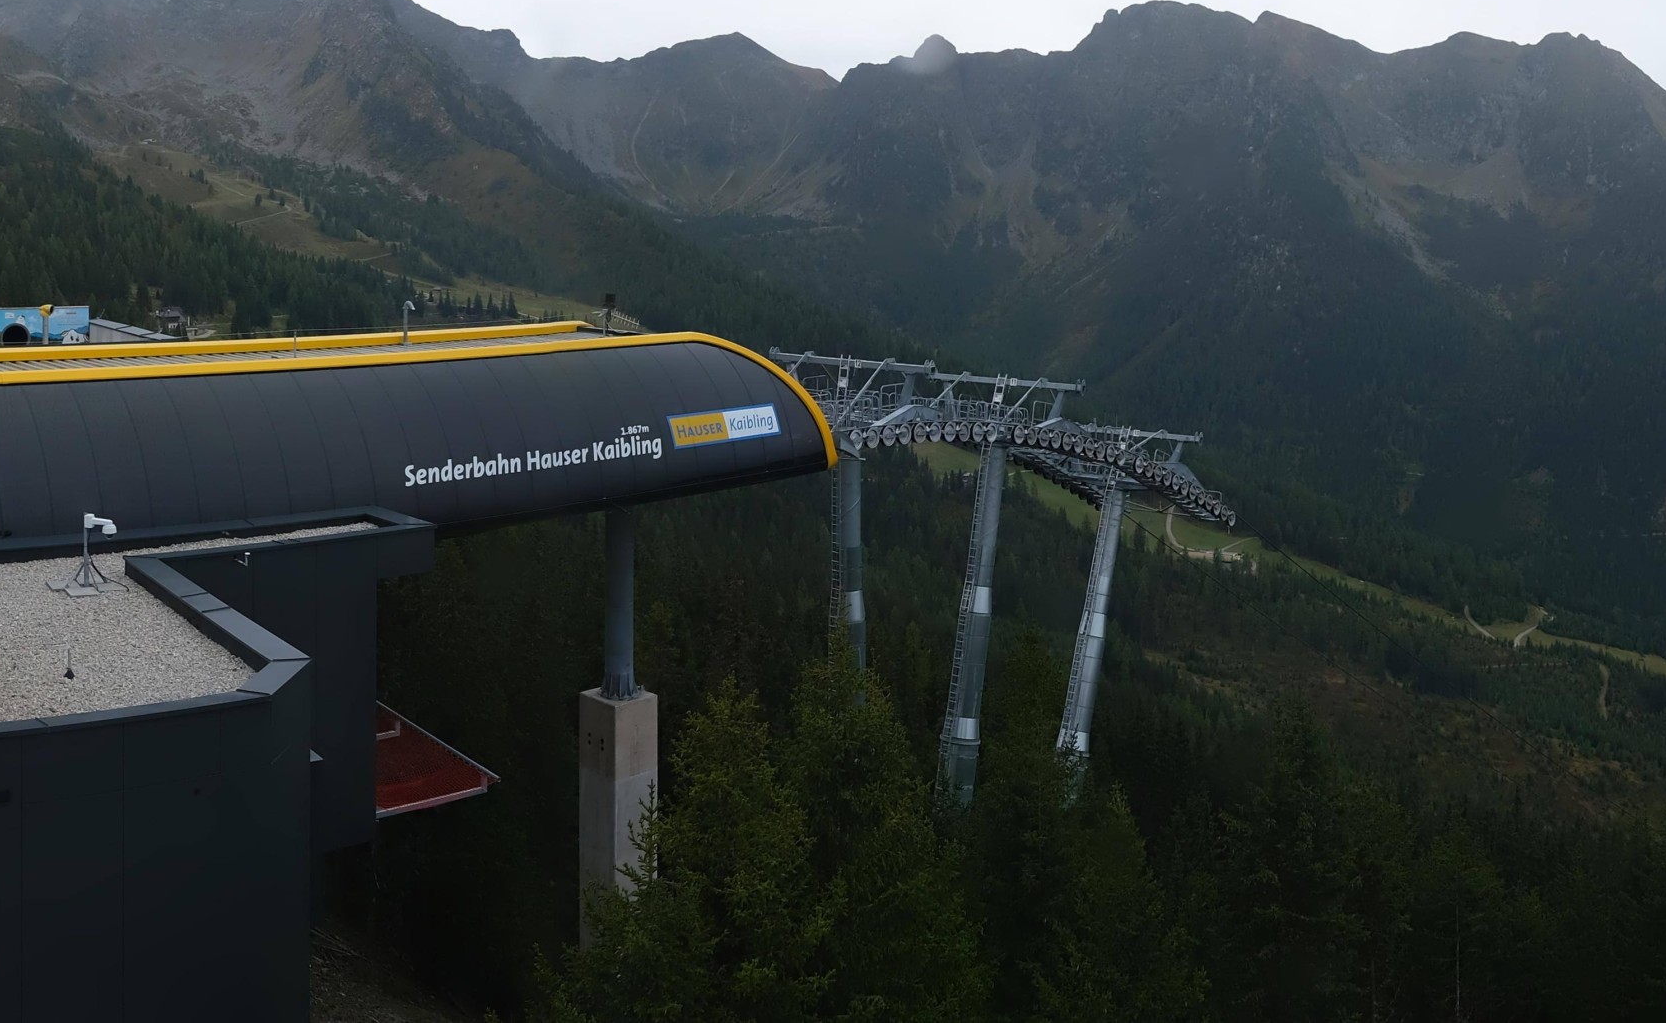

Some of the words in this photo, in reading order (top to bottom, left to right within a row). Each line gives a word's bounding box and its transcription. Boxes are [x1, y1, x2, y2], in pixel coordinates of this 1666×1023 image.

[620, 425, 649, 436] 1.867m
[676, 422, 724, 440] HAUSER
[729, 414, 774, 432] Kaibling
[404, 451, 522, 487] Senderbahn
[526, 448, 589, 471] Hauser
[593, 436, 662, 461] Kaibling
